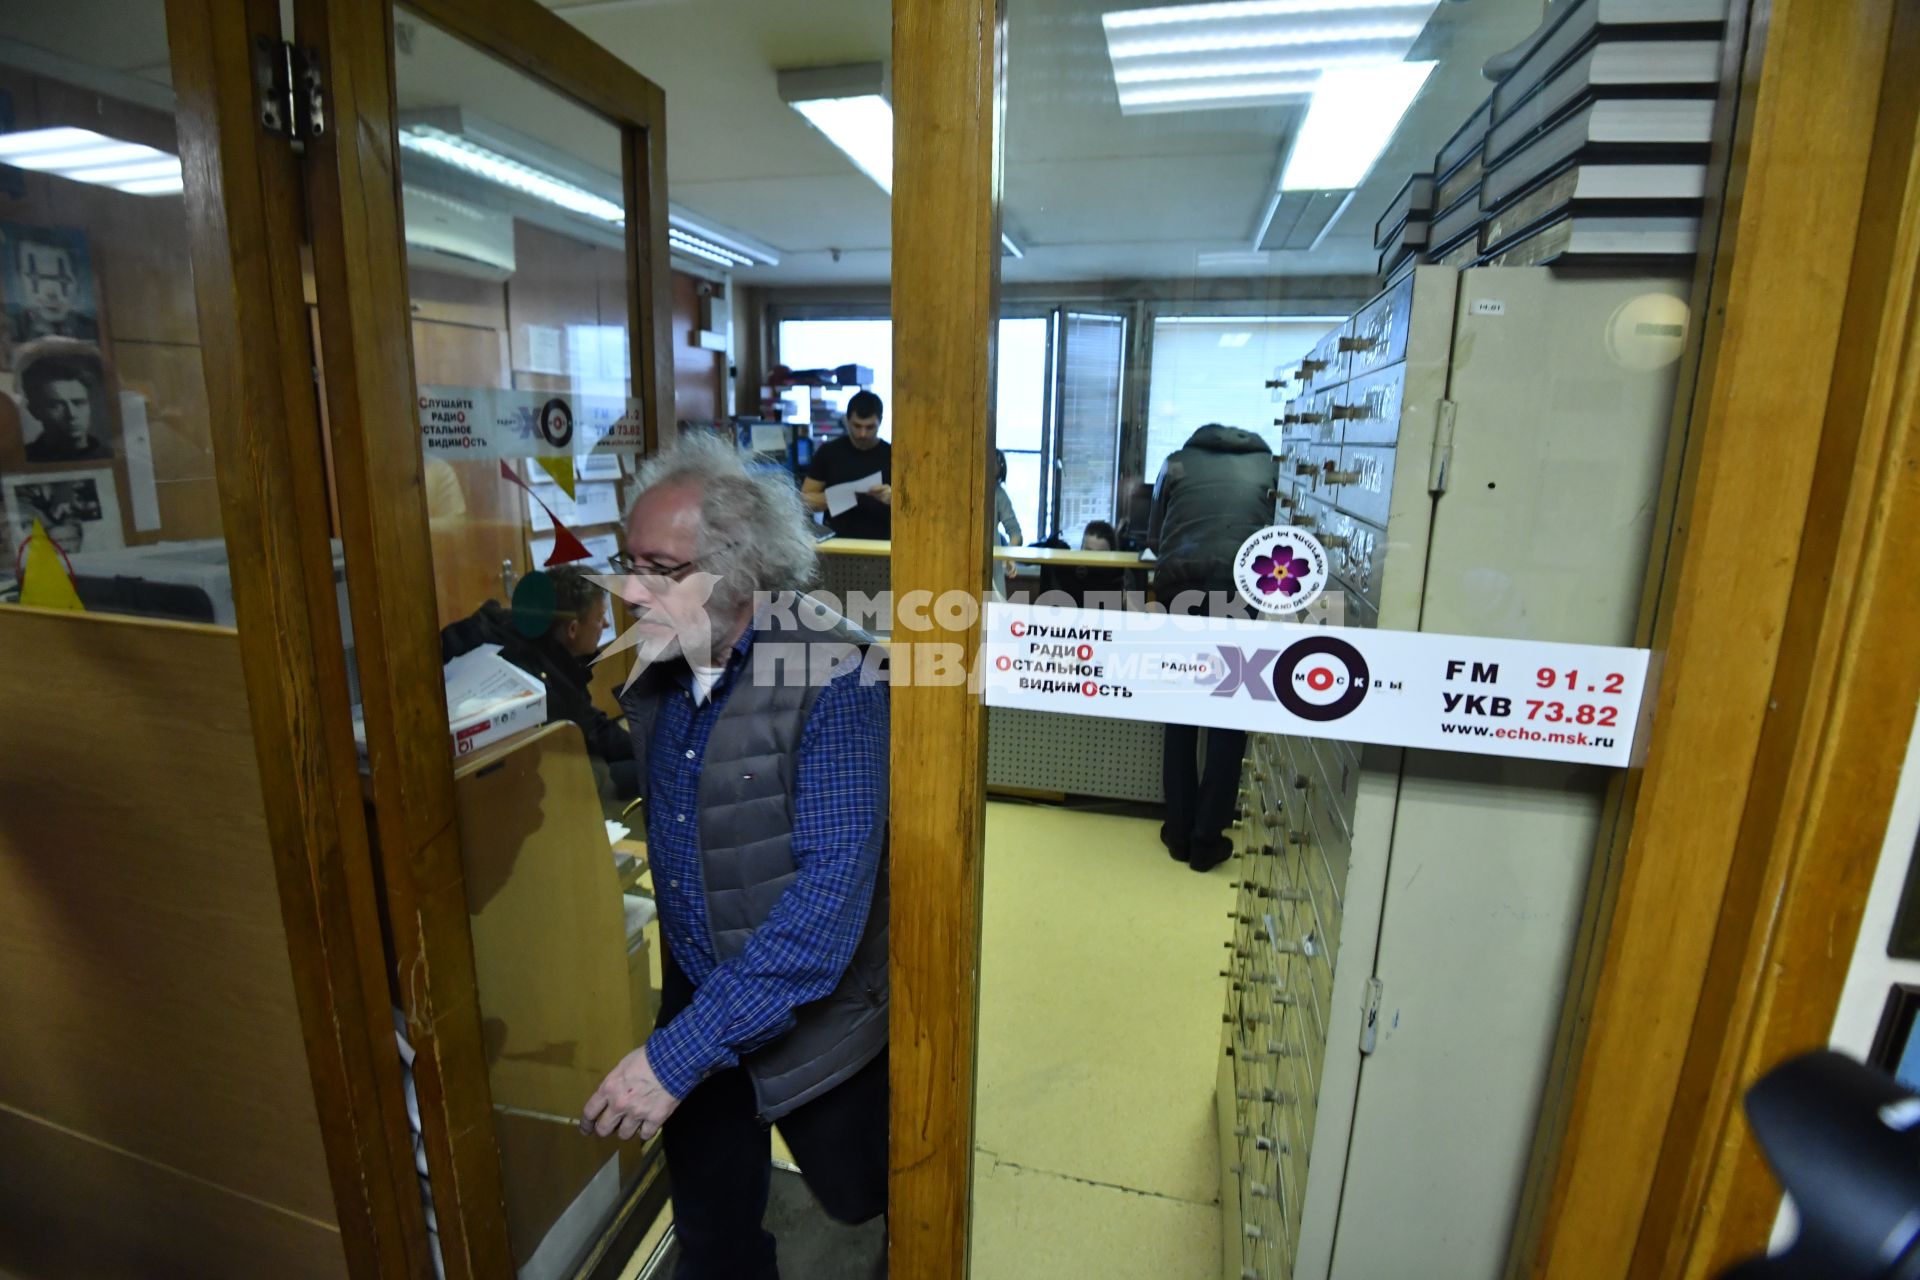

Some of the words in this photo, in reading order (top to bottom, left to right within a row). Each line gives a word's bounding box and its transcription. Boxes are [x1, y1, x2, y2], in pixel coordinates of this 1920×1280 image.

[419, 396, 473, 410] СЛУШАЙТЕ
[431, 411, 465, 423] РАДИО
[428, 436, 487, 449] ВИДИМОСТЬ
[1274, 601, 1292, 610] AND
[1292, 581, 1320, 608] DEMAND
[1010, 621, 1113, 642] СЛУШАЙТЕ
[1030, 643, 1093, 661] РАДИО
[996, 655, 1104, 678] ОСТАЛЬНОЕ
[1161, 661, 1207, 673] РАДИО
[1445, 660, 1499, 684] FM
[1536, 667, 1625, 694] 91.2
[1019, 677, 1132, 698] ВИДИМОСТЬ
[1443, 693, 1512, 717] УКВ
[1526, 699, 1618, 727] 73.82
[1441, 722, 1614, 748] www.echo.msk.ru
